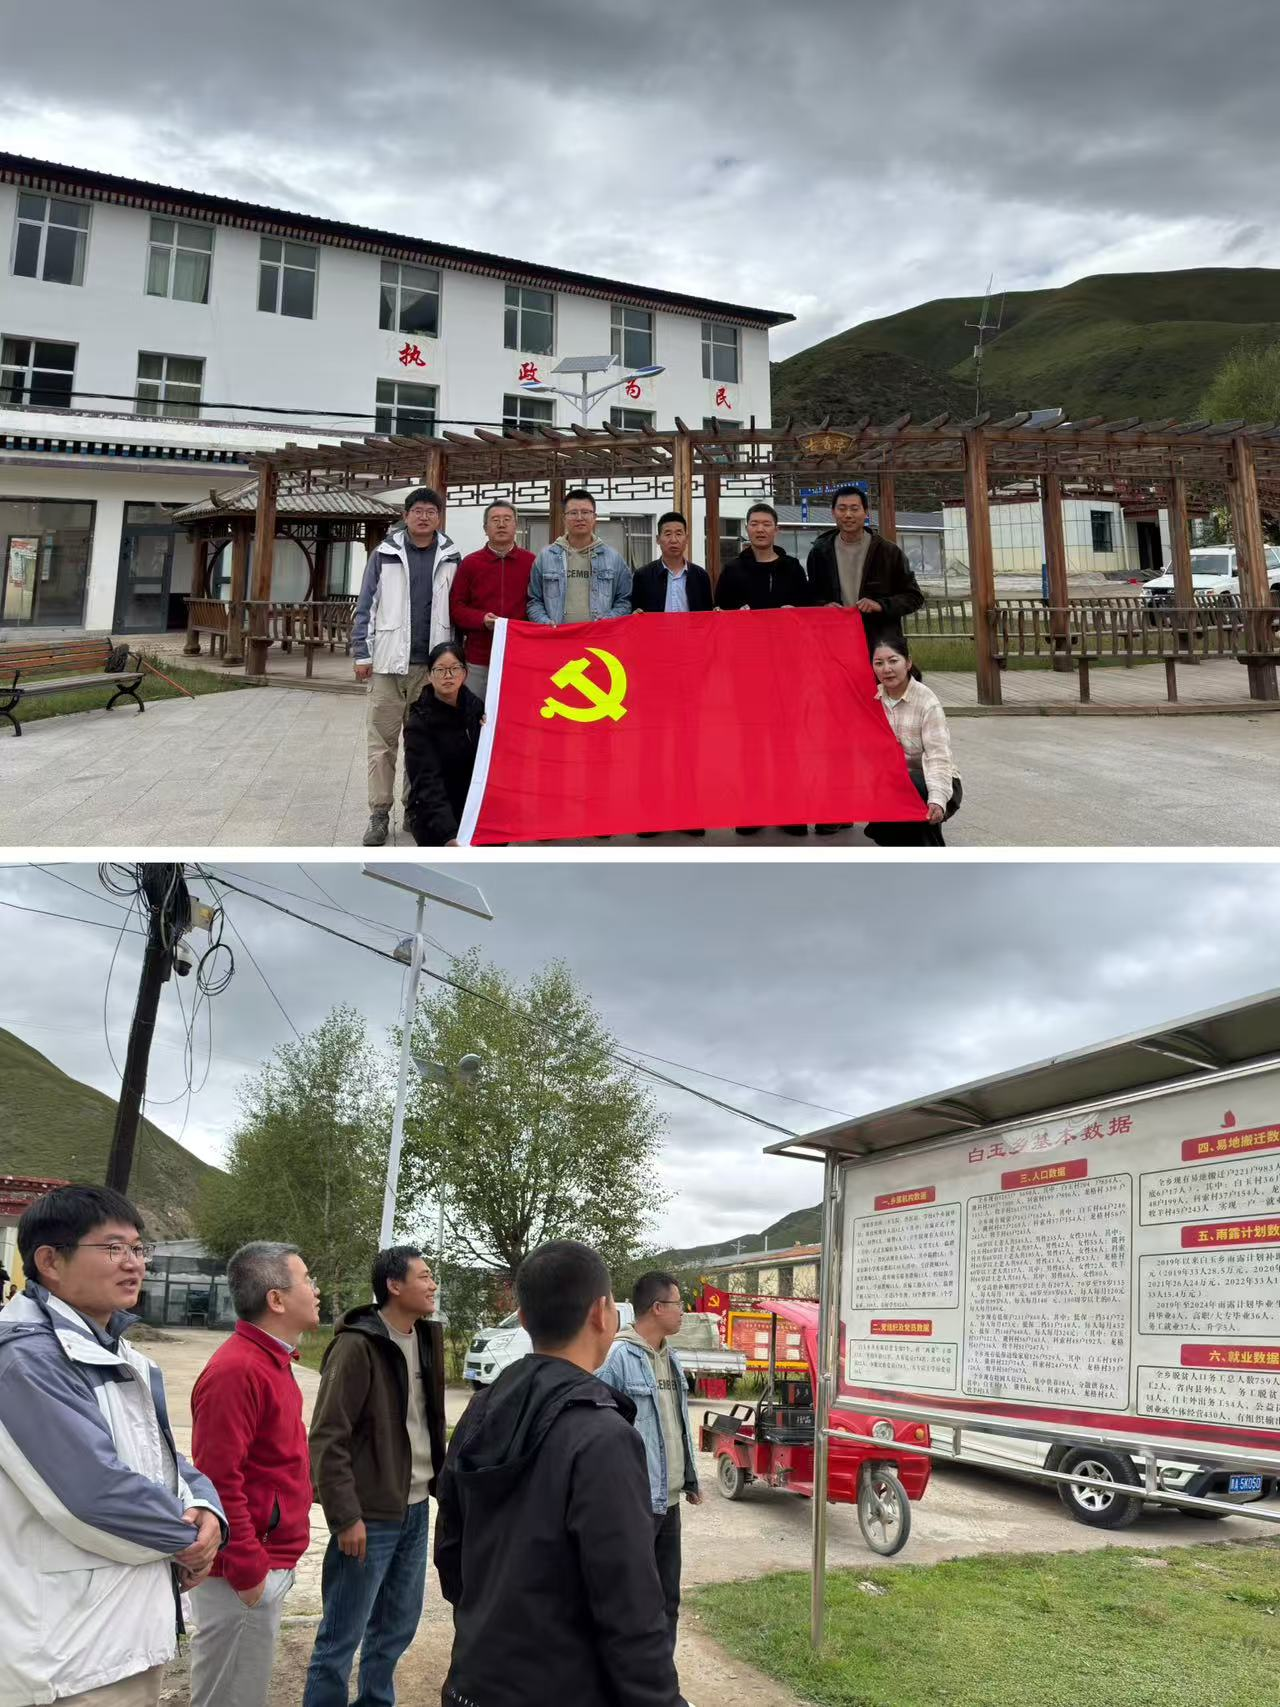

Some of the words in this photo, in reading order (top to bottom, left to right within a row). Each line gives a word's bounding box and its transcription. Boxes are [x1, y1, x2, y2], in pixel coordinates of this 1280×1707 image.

[967, 1114, 1133, 1164] 白玉乡基本数据
[1020, 1167, 1067, 1184] 三、人口数据
[1209, 1350, 1280, 1365] 六、就业数据
